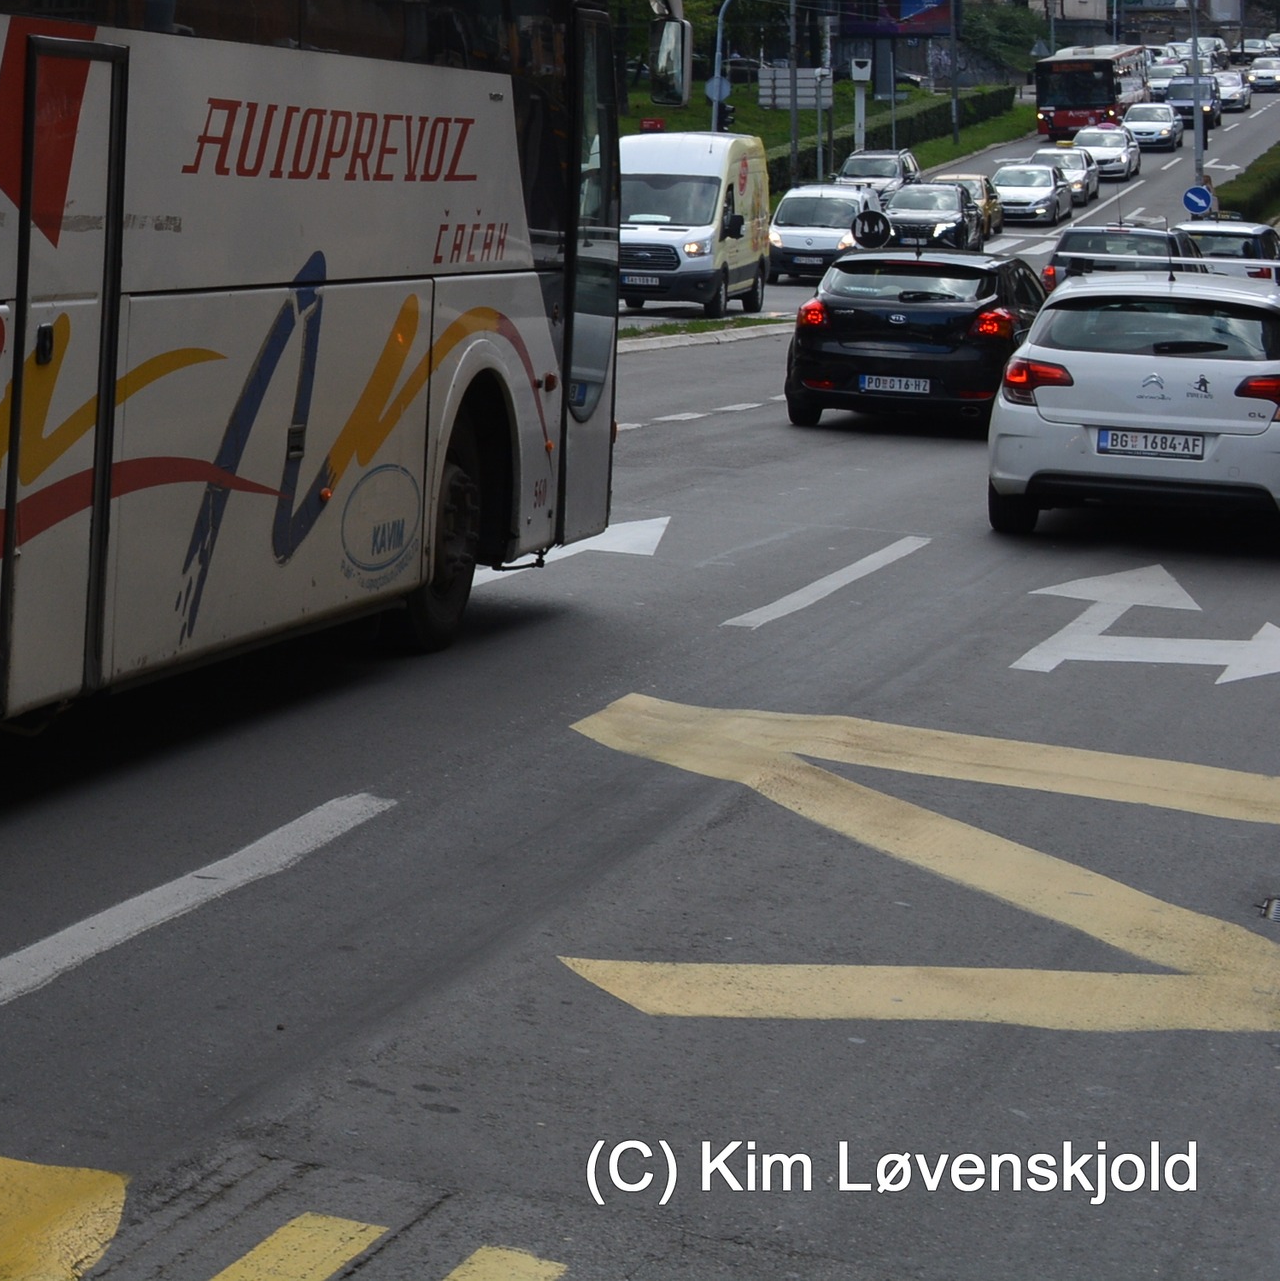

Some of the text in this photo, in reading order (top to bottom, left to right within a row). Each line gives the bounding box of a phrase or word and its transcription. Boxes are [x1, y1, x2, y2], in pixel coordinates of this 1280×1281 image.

[181, 97, 478, 182] AUTOPREVOZ
[433, 209, 508, 264] ČAČAK
[867, 377, 881, 388] PO
[1110, 433, 1128, 448] BG
